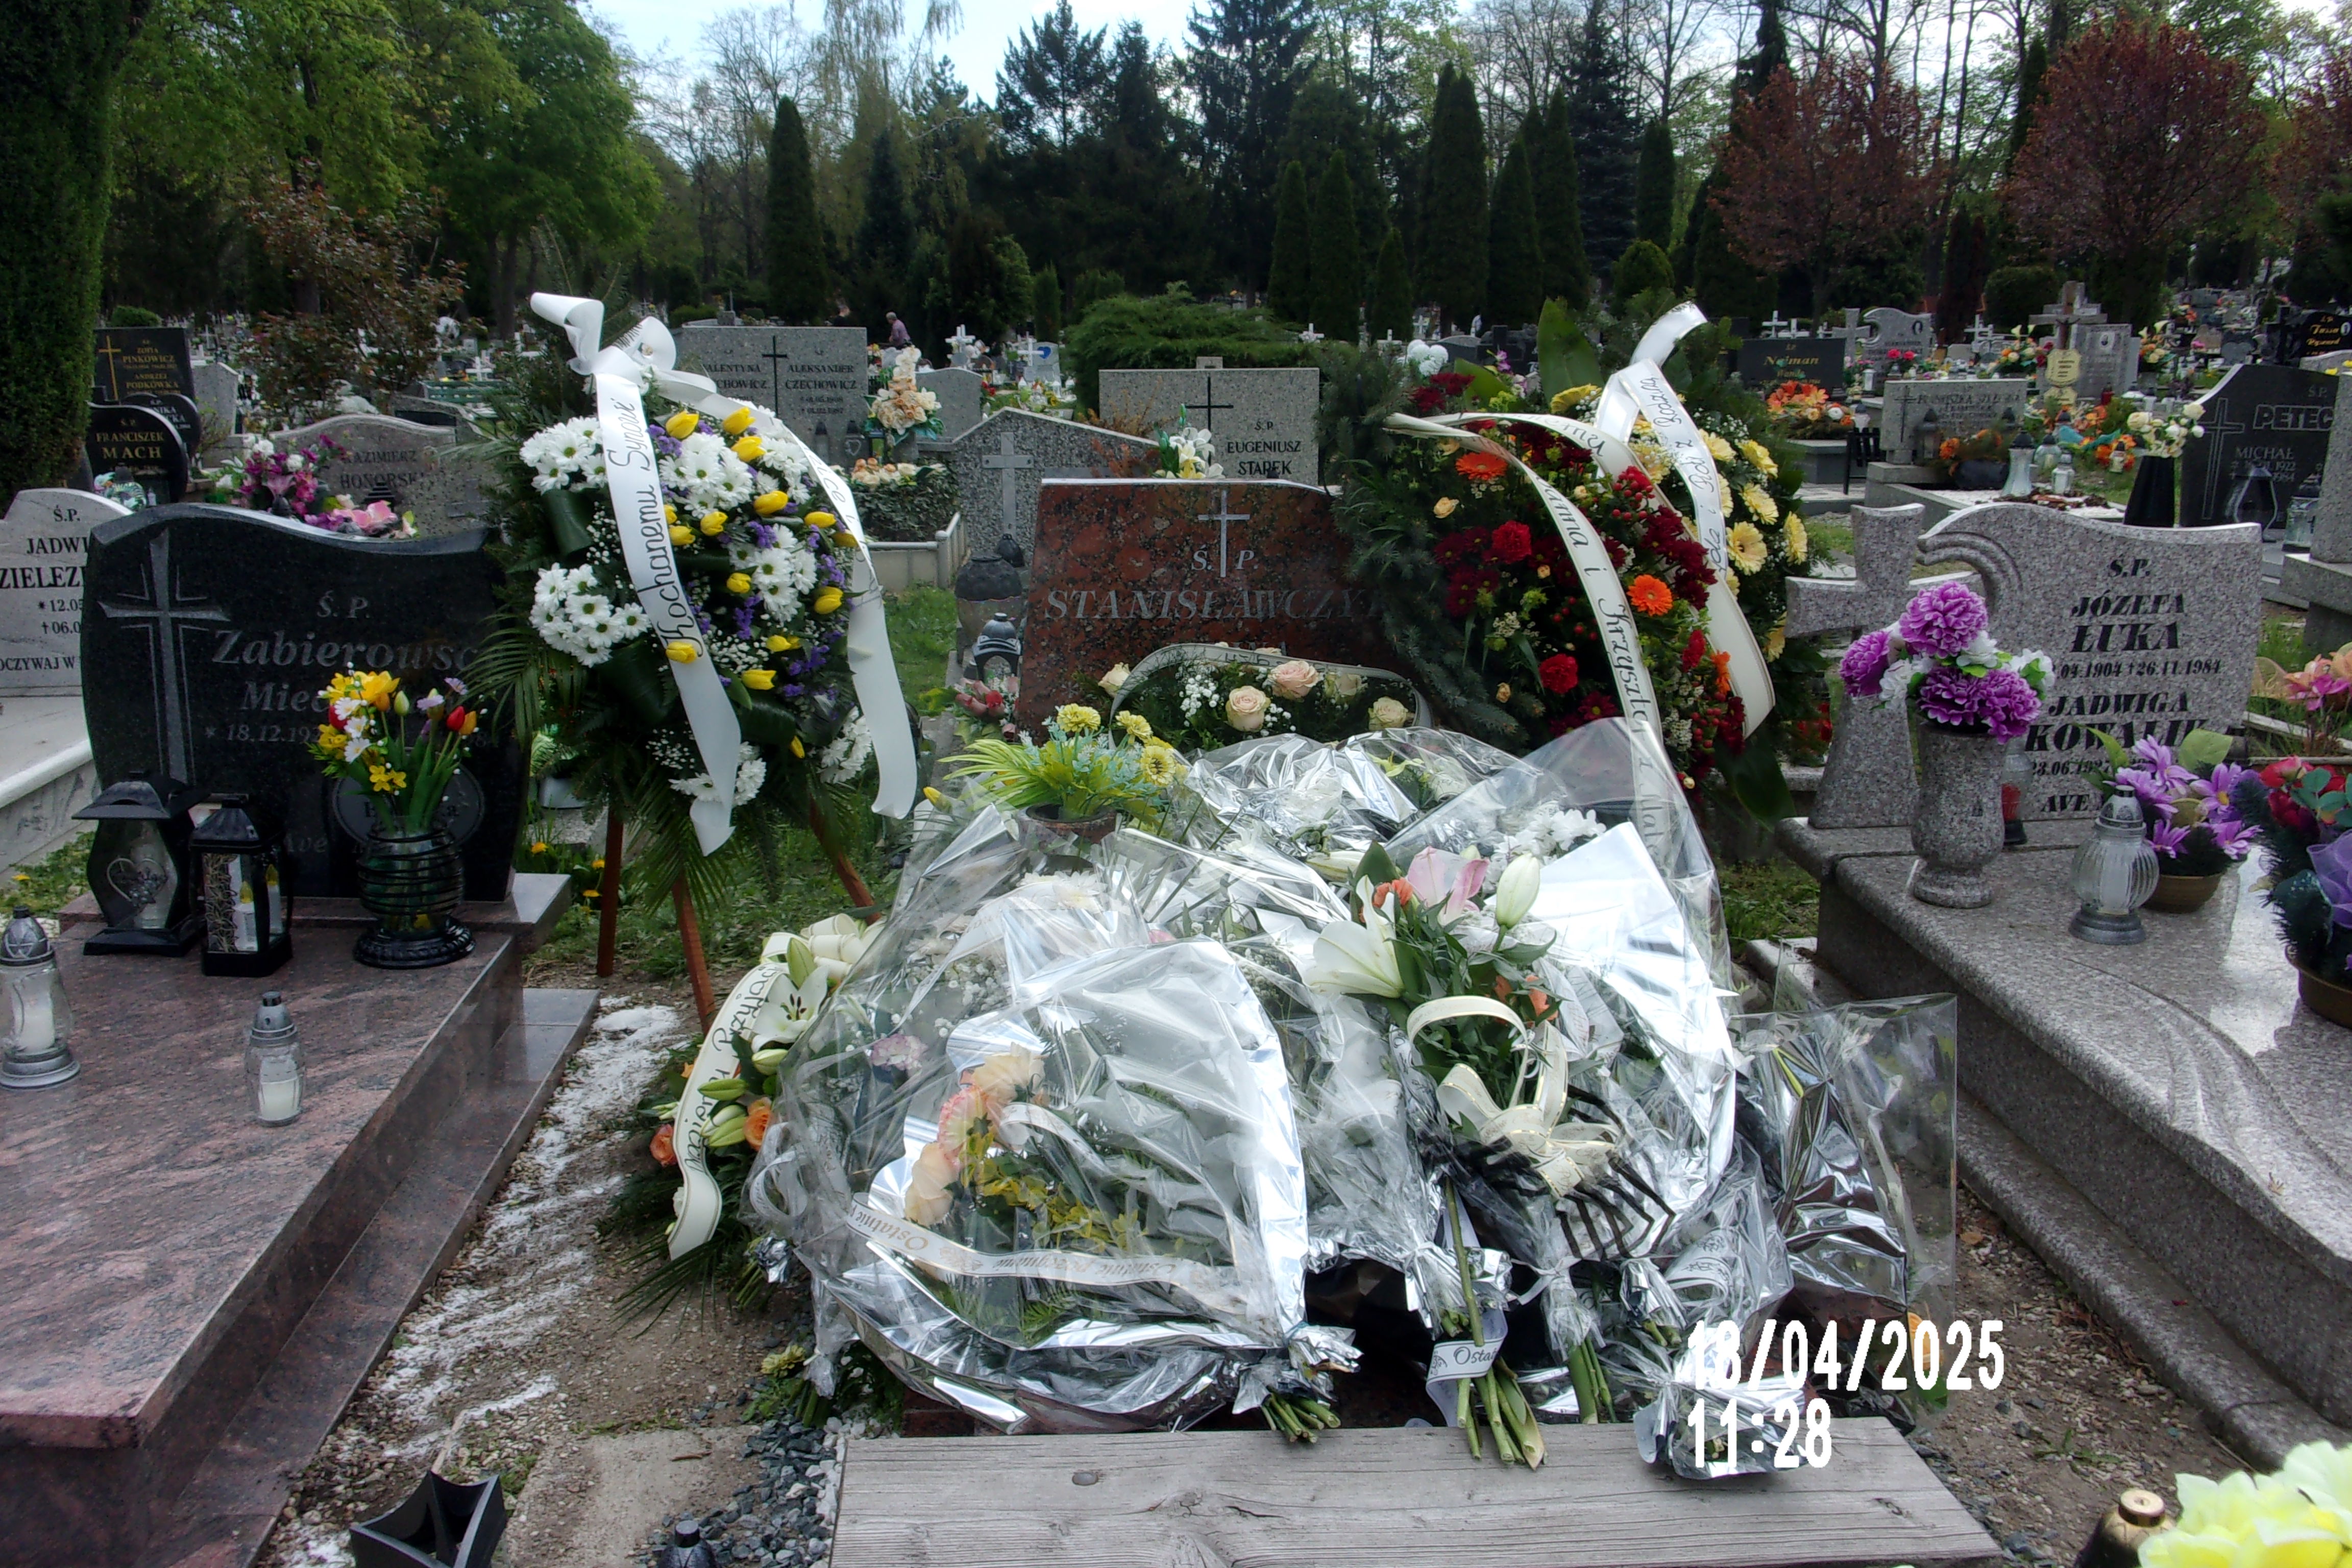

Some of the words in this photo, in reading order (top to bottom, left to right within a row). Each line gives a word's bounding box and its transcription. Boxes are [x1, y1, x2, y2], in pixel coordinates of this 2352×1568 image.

[787, 363, 854, 373] ALEKSANDER
[785, 379, 857, 390] CZECHOWICZ
[95, 432, 164, 443] FRANCISZEK
[102, 446, 162, 459] MACH
[1227, 440, 1302, 454] EUGENIUSZ
[2235, 446, 2295, 460] MICHAŁ
[1584, 566, 1608, 577] i
[2071, 589, 2186, 618] JÓZEFA
[2069, 621, 2181, 653] ŁUKA
[63, 656, 76, 669] W
[2047, 691, 2190, 717] JADWIGA
[2041, 793, 2090, 813] AVE
[856, 1212, 929, 1253] Ostatnie
